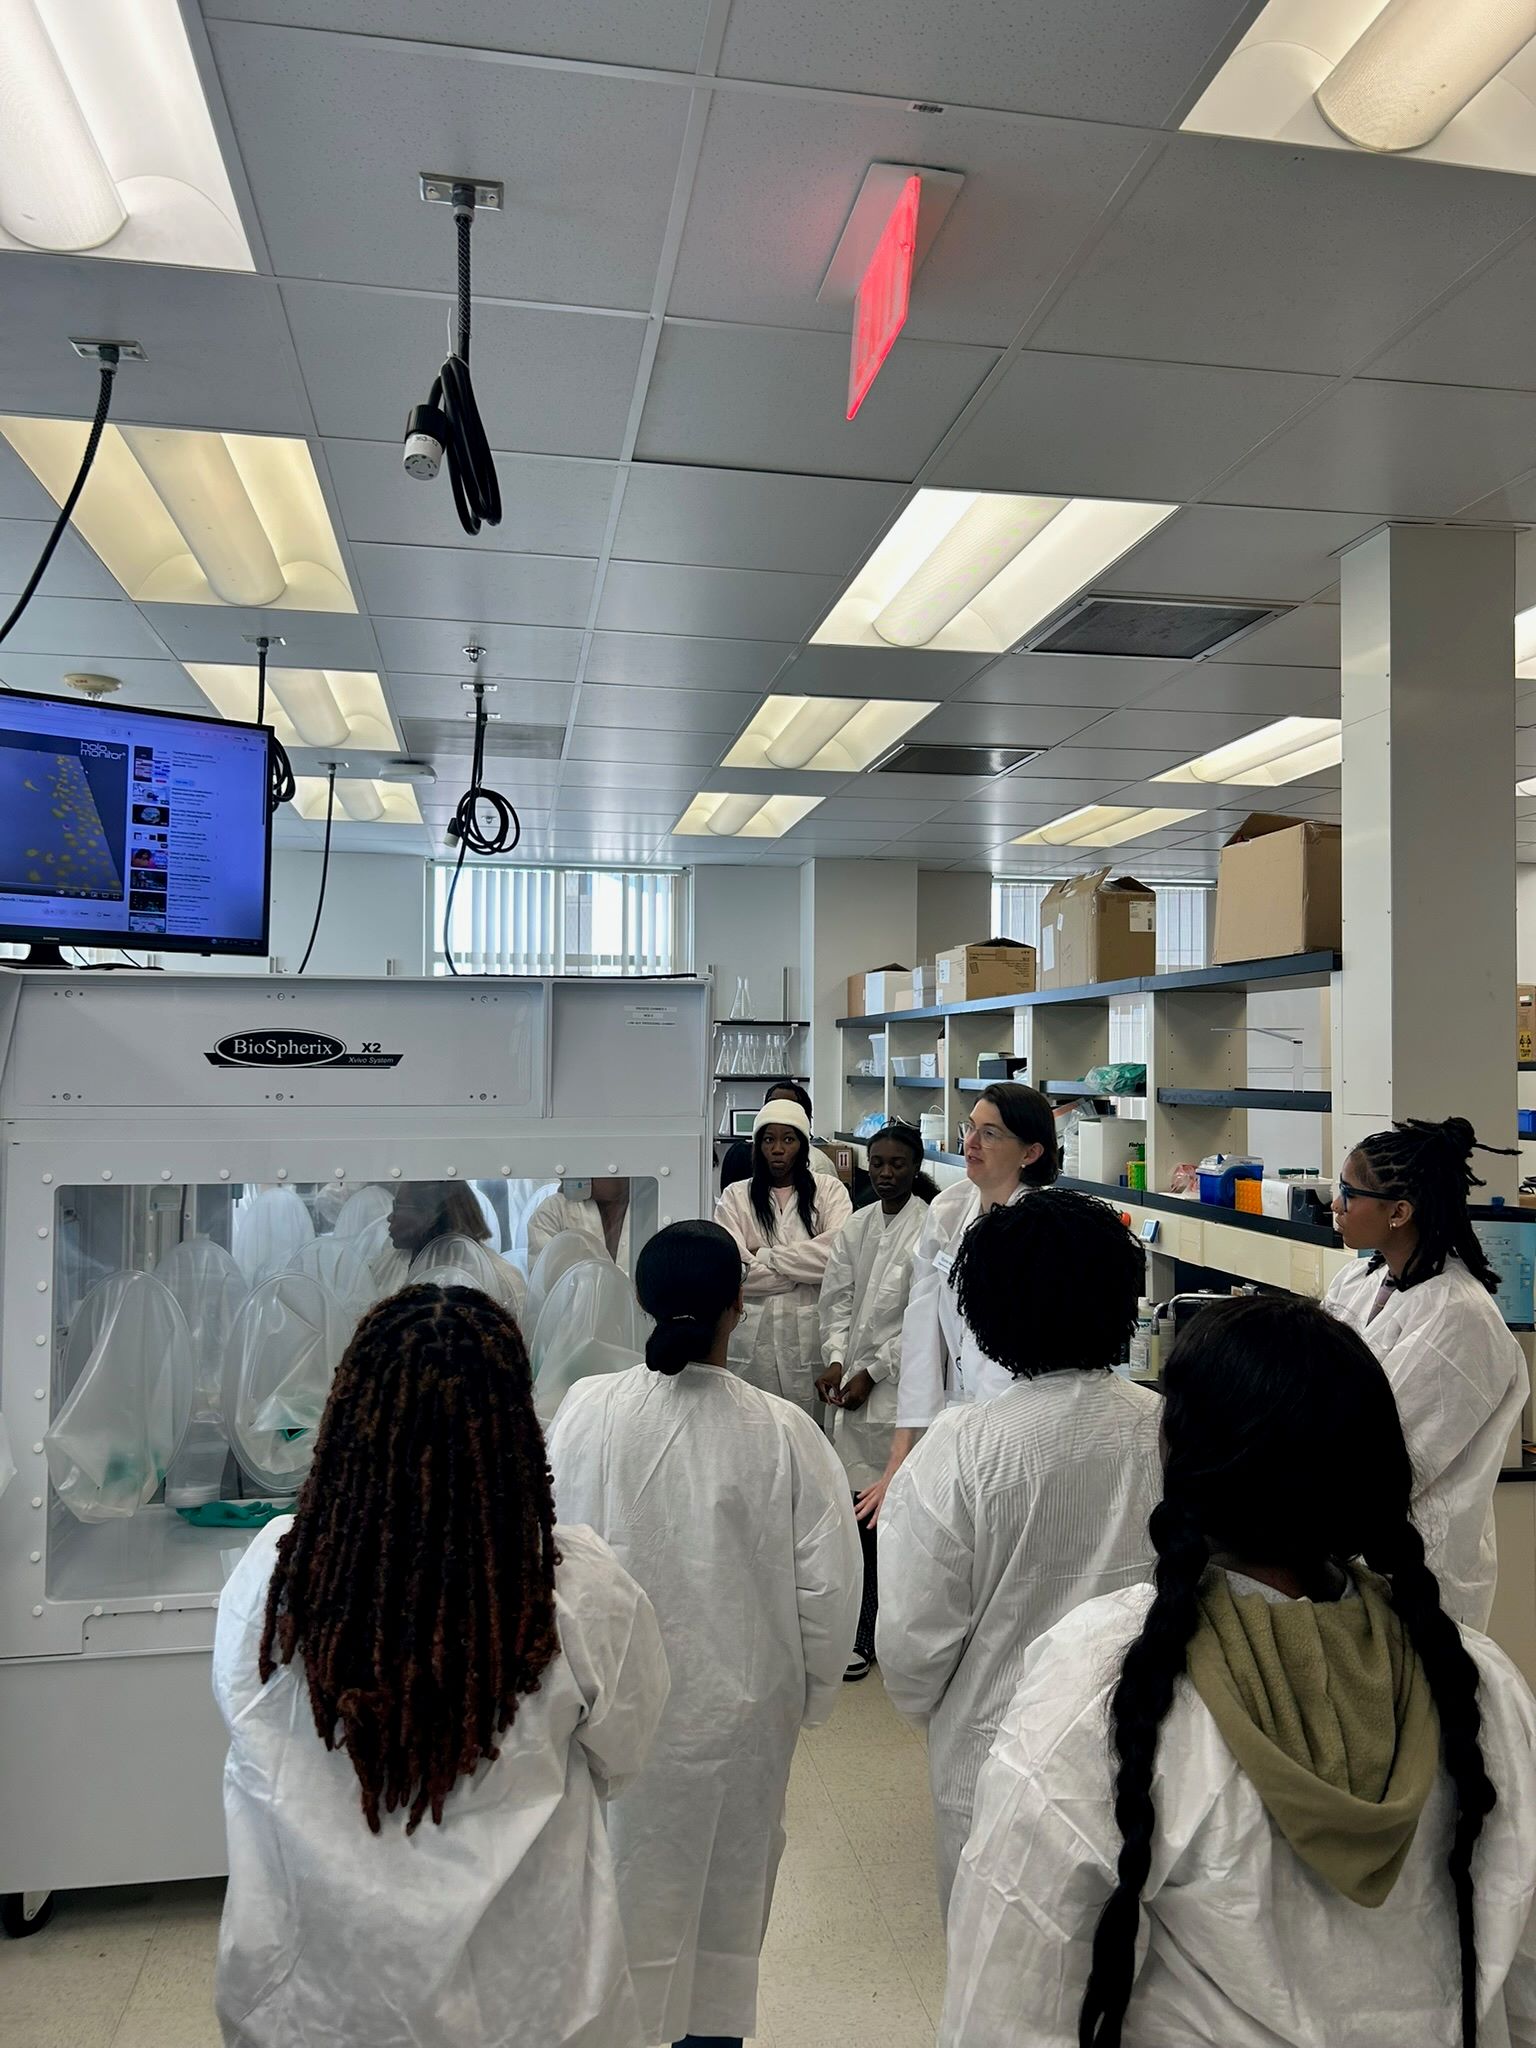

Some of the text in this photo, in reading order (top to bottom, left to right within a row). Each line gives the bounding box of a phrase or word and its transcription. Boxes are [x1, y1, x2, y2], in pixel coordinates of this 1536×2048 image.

[80, 740, 107, 752] holo
[80, 749, 123, 760] monitor
[233, 1038, 333, 1059] BioSpherix
[361, 1042, 382, 1053] X2
[348, 1056, 394, 1065] Xvivo System
